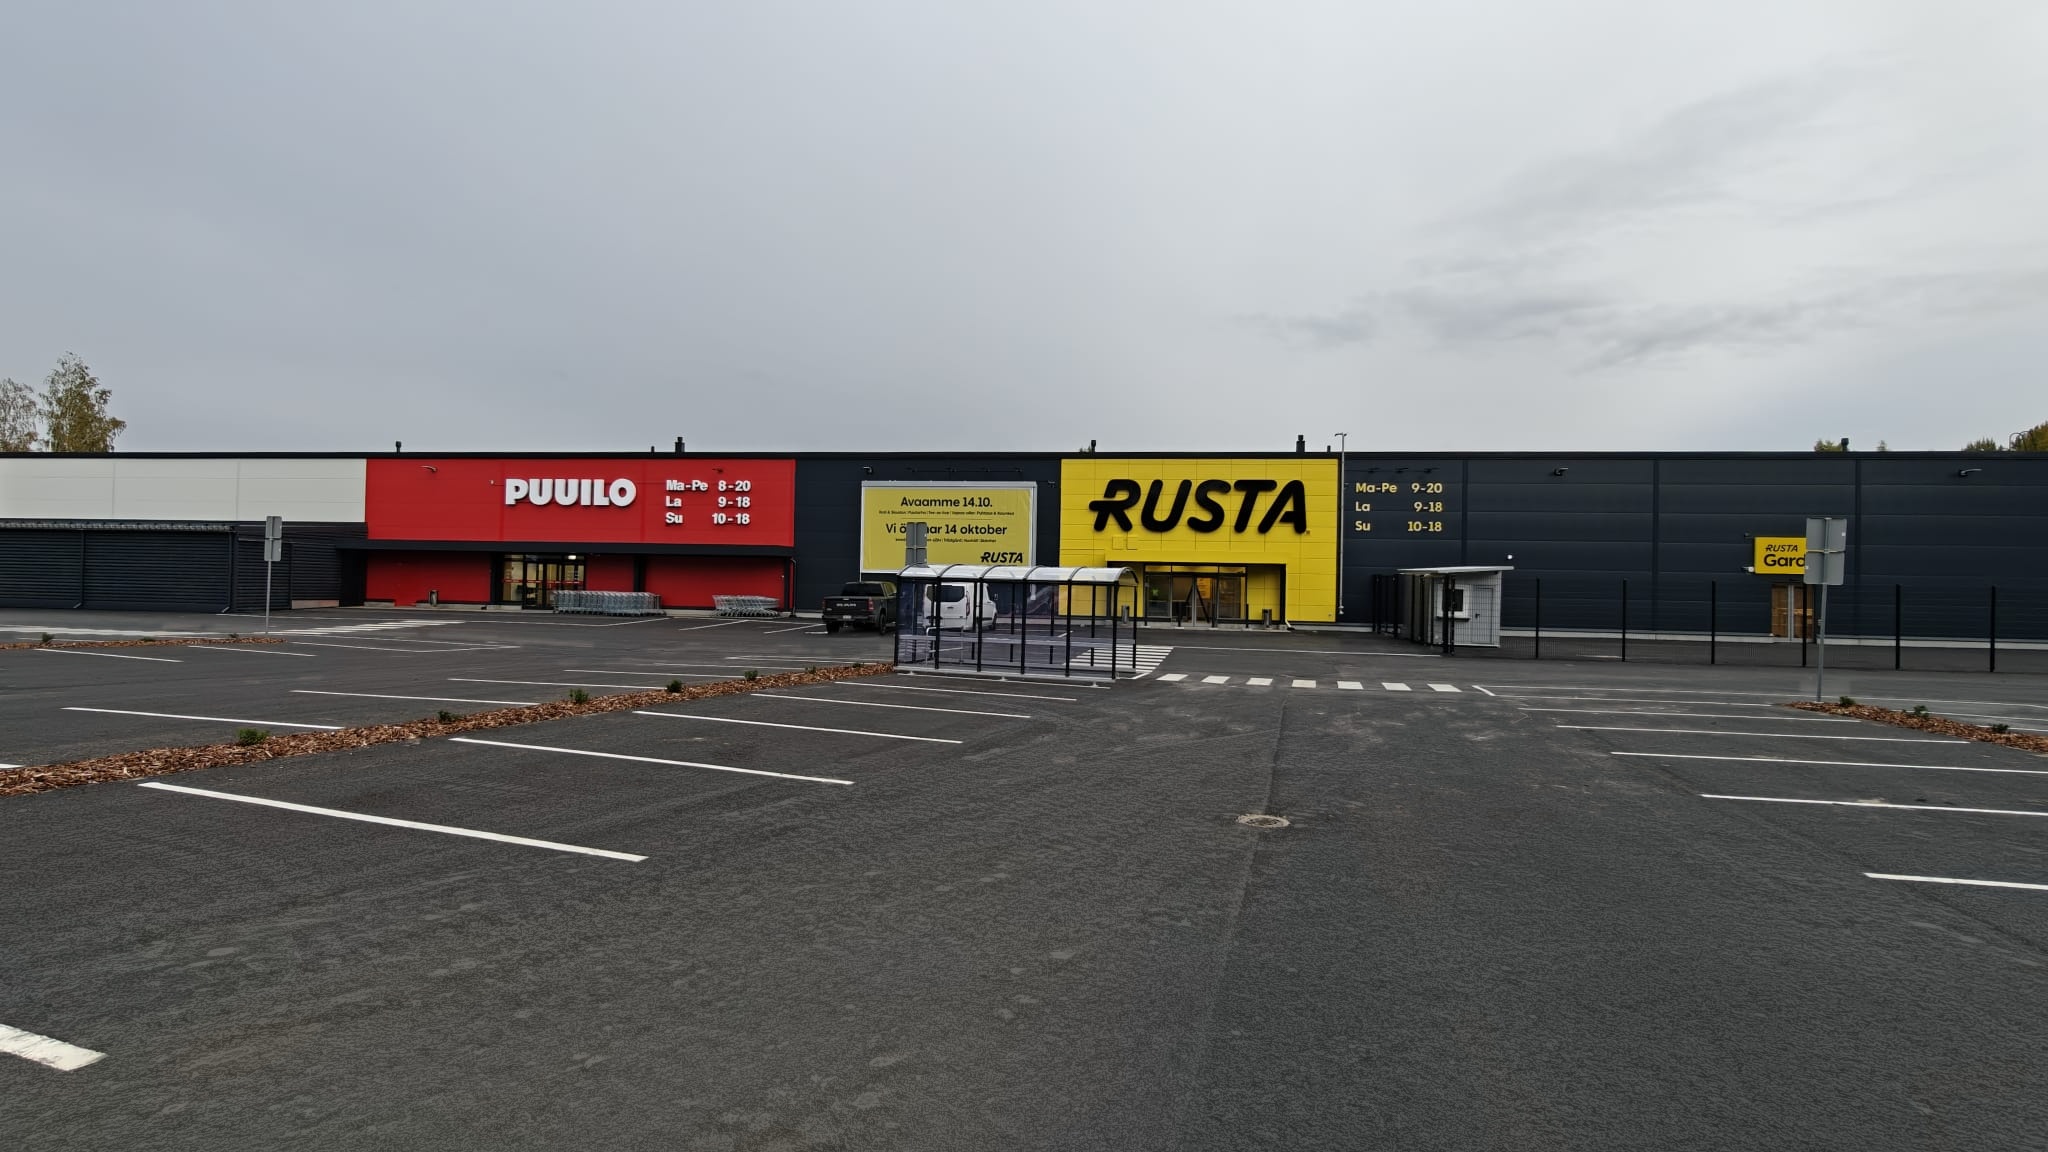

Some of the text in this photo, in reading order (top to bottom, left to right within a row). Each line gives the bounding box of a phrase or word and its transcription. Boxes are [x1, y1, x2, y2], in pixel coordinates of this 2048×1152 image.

[666, 479, 708, 491] Ma-Pe
[1355, 482, 1443, 494] Ma-Pe 9-20
[505, 478, 637, 506] PUUILO
[666, 495, 682, 507] La
[900, 496, 993, 508] Avaamme 14.10.
[1089, 479, 1307, 535] RUSTA
[1355, 501, 1443, 513] La 9-18
[666, 512, 683, 524] Su
[886, 523, 896, 534] Vi
[945, 524, 957, 534] 14
[960, 524, 1008, 535] oktober
[1355, 520, 1443, 532] Su 10-18
[1764, 543, 1798, 553] RUSTA
[980, 551, 1024, 564] RUSTA
